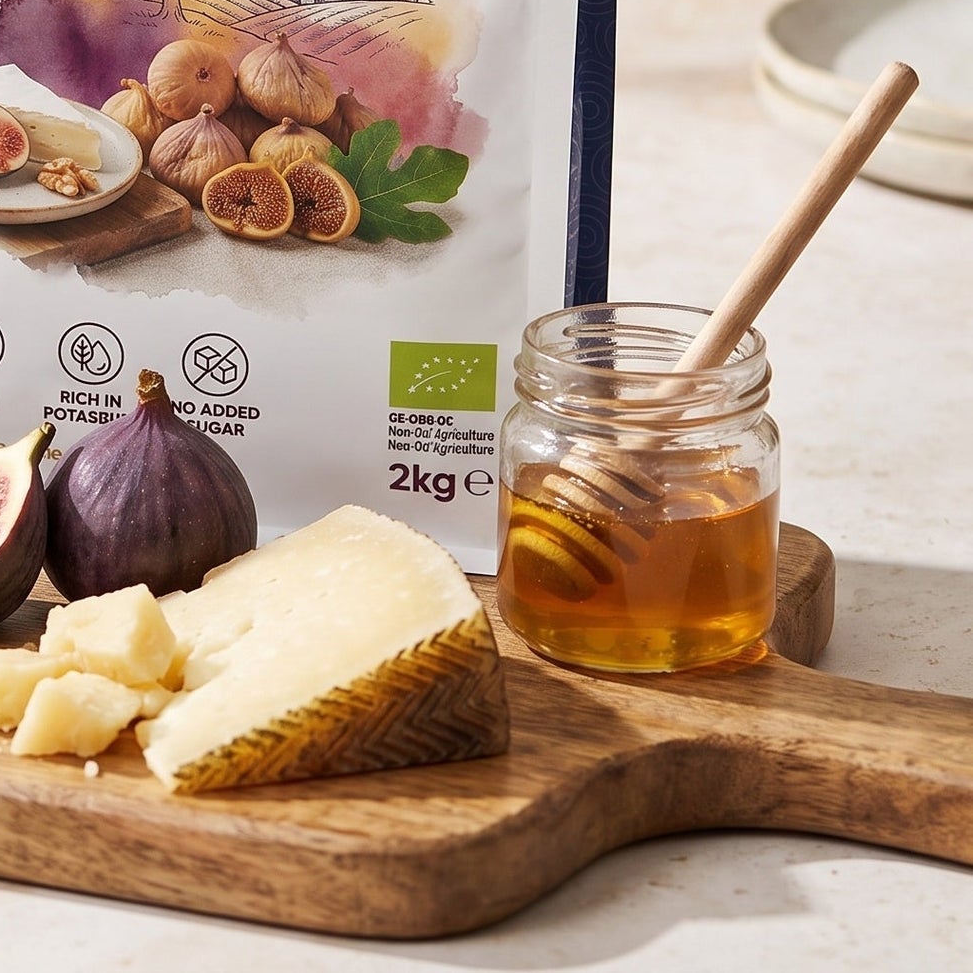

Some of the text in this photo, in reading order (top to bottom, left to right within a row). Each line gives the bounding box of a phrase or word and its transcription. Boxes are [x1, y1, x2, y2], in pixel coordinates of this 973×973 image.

[60, 390, 122, 408] RICH IN
[200, 402, 261, 420] ADDED
[389, 463, 456, 503] 2kg
